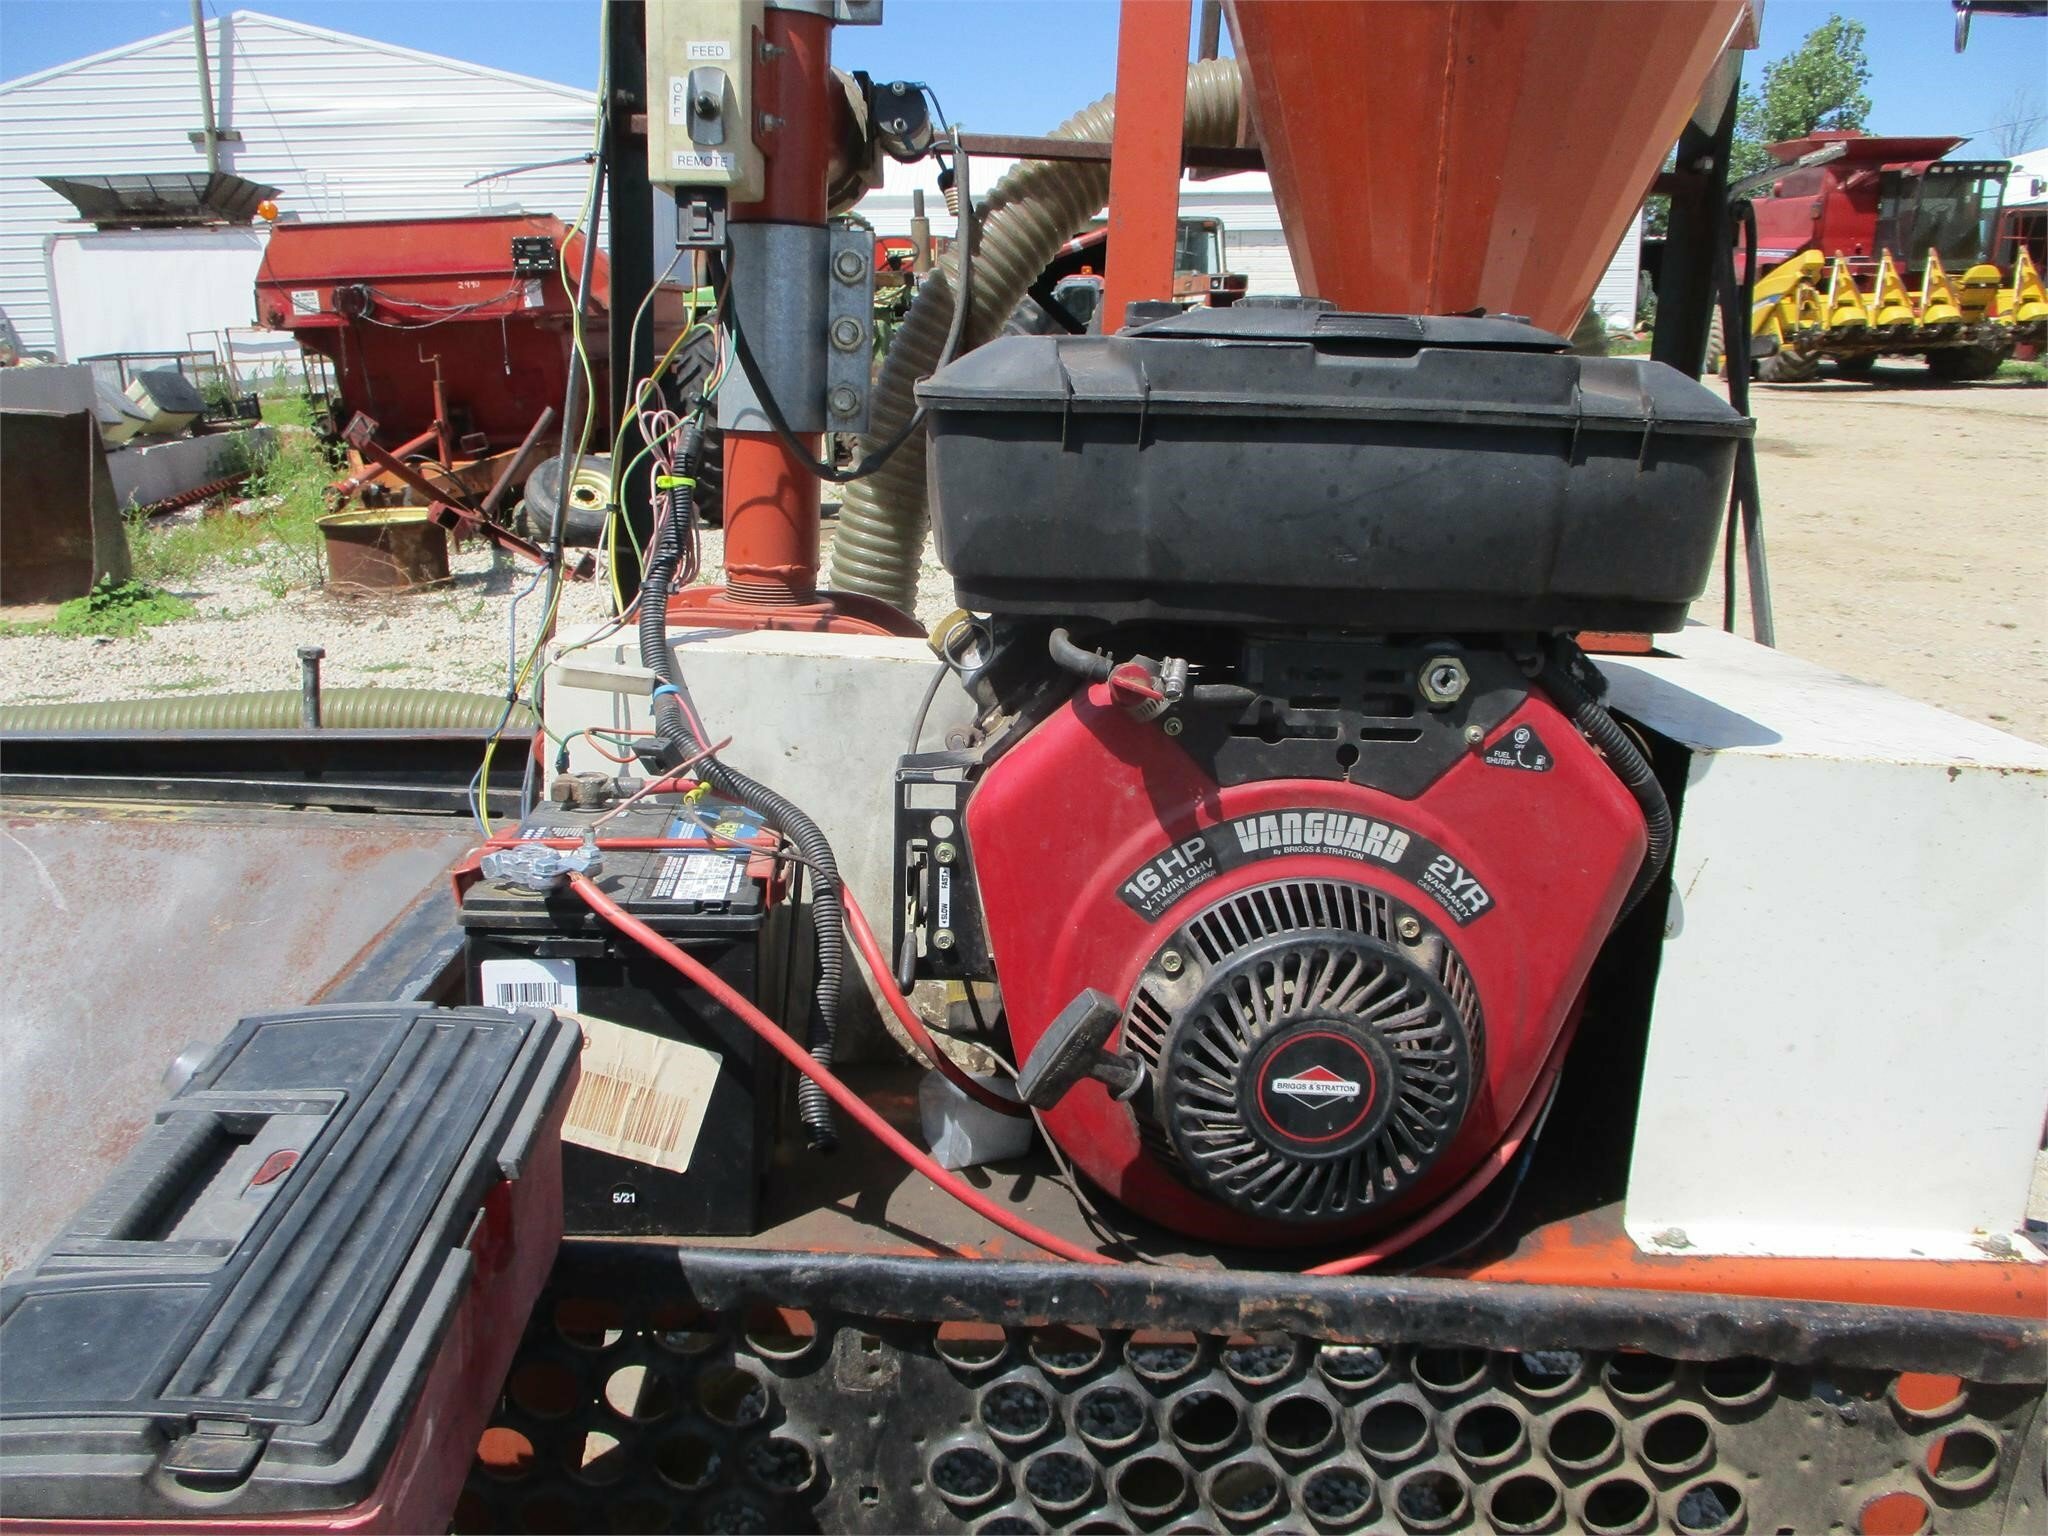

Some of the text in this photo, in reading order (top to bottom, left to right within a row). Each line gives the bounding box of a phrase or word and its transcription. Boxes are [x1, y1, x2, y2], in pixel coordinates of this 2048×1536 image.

[691, 45, 725, 57] FEED
[673, 82, 683, 117] OFF
[677, 155, 728, 168] REMOTE
[1486, 756, 1517, 766] SHUTOFF
[1494, 750, 1511, 759] FUEL
[1233, 812, 1411, 864] VANGUARD
[1283, 845, 1315, 854] BRIGGS
[1322, 846, 1365, 861] STRATTON
[941, 874, 949, 889] FAST
[1141, 856, 1213, 911] V-TWIN OHV
[1416, 879, 1436, 894] CAST
[1423, 871, 1472, 917] WARRANTY
[1276, 1082, 1307, 1090] BRIGGS
[1316, 1084, 1356, 1092] STRATTON
[612, 1192, 636, 1204] 5/21
